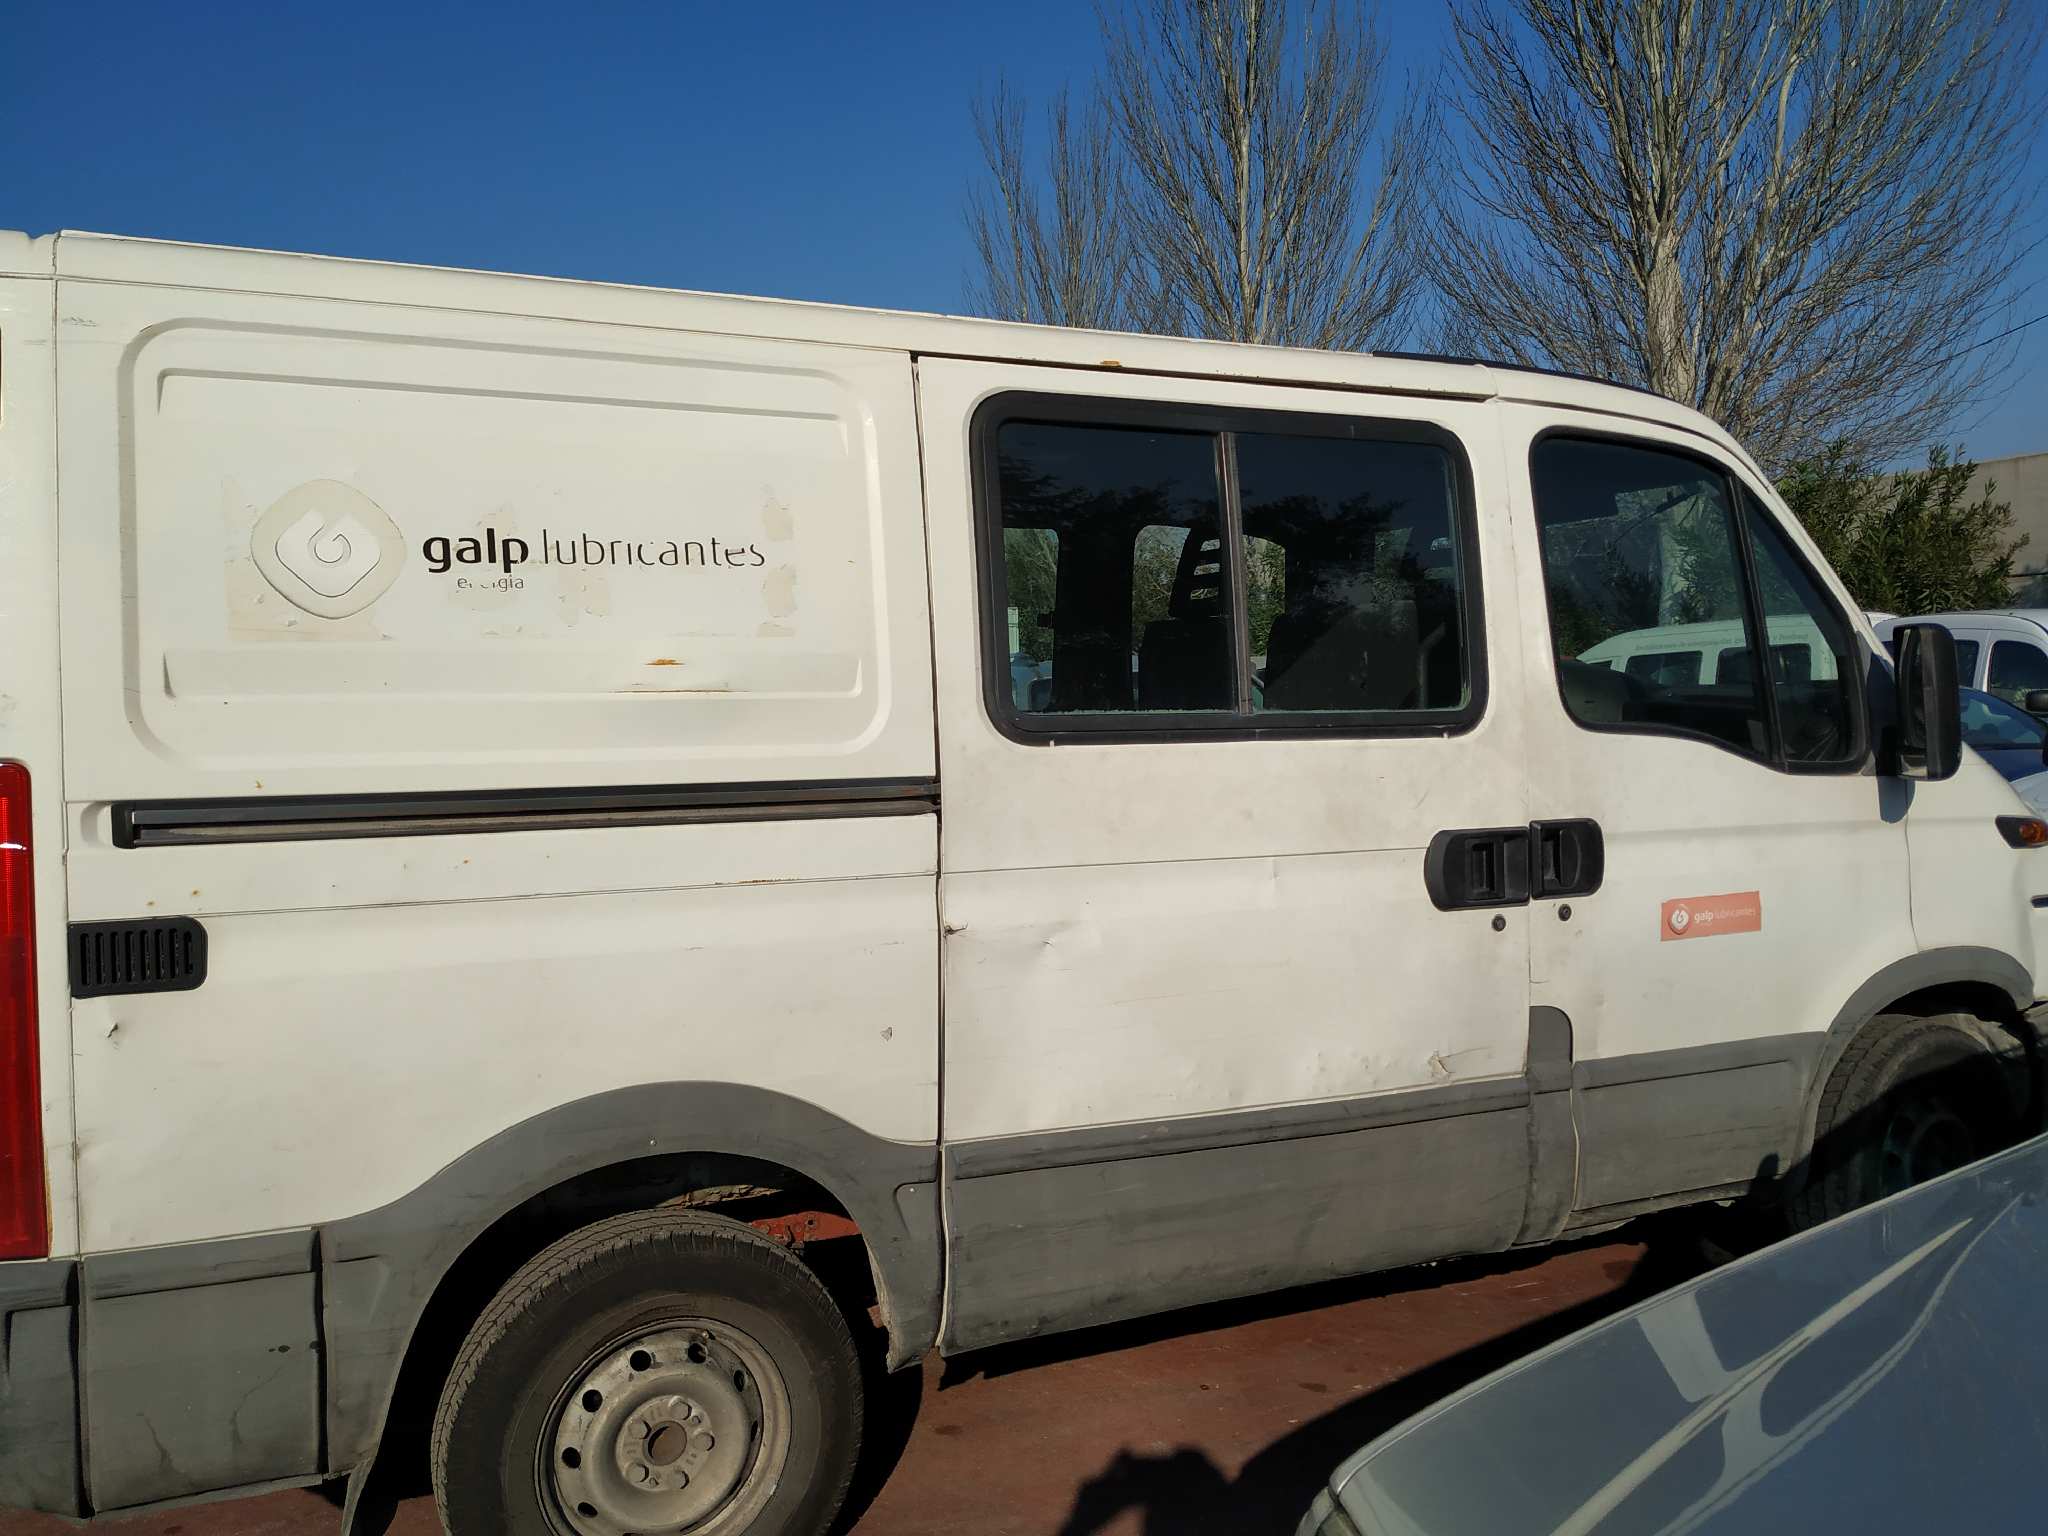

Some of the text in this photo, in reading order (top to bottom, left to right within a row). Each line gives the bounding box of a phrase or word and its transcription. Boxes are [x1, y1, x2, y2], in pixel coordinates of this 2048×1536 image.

[422, 527, 765, 573] galp lubricantes
[1694, 910, 1714, 924] galp
